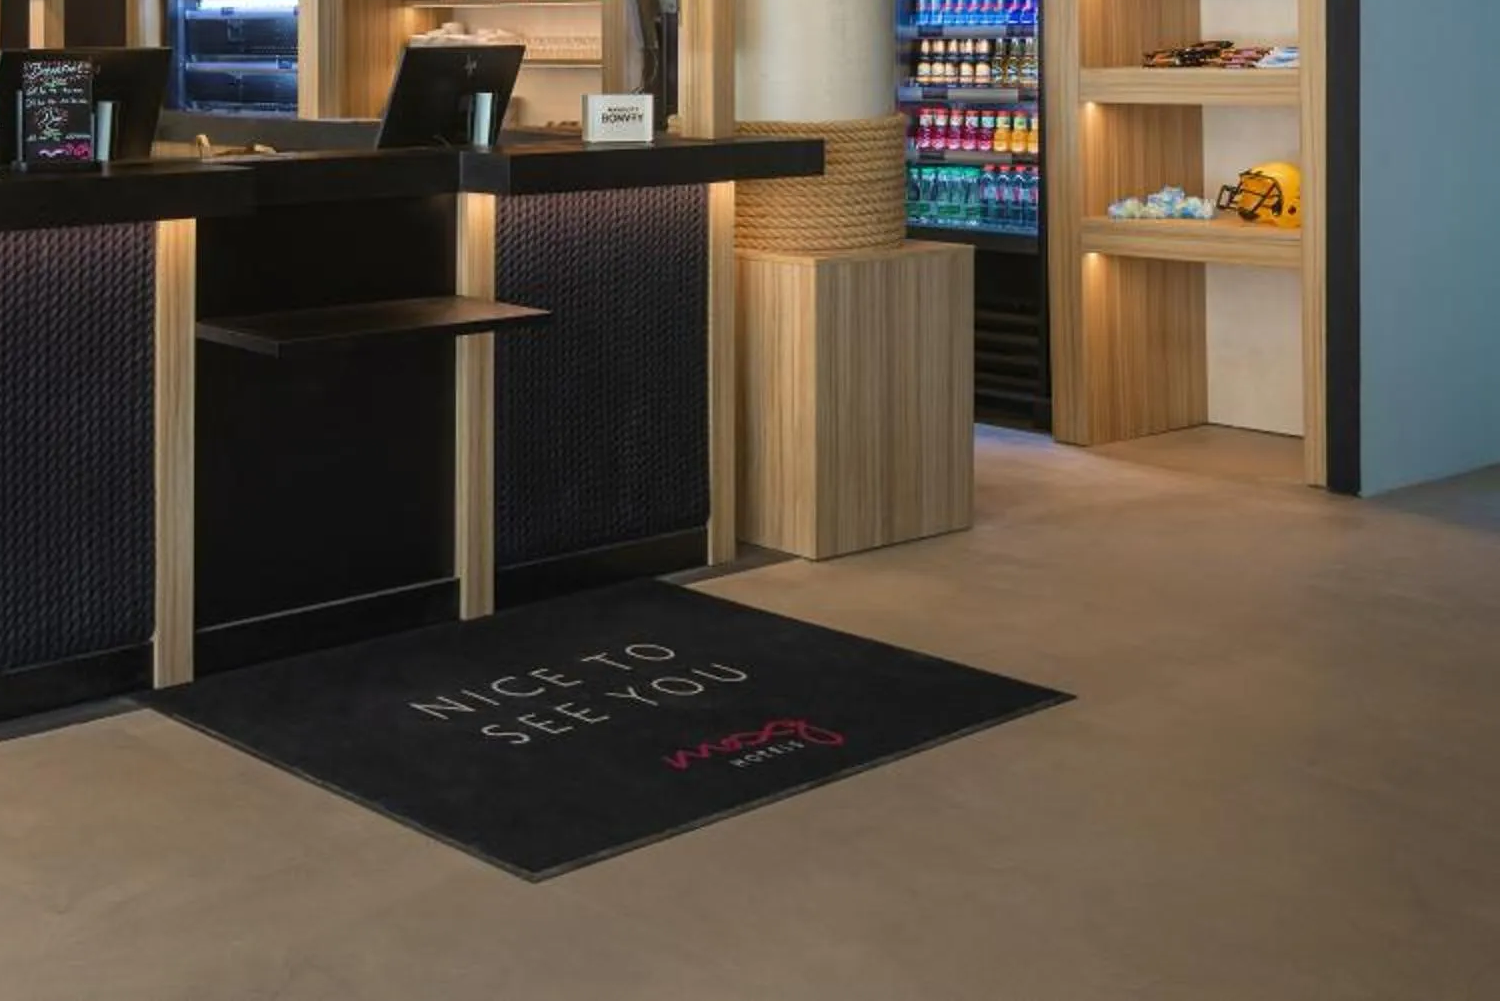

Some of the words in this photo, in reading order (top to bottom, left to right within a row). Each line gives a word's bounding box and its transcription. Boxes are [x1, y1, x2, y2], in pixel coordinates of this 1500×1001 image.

[409, 668, 582, 720] NICE
[581, 643, 676, 671] TO
[481, 701, 610, 744] SEE
[605, 663, 748, 706] YOU
